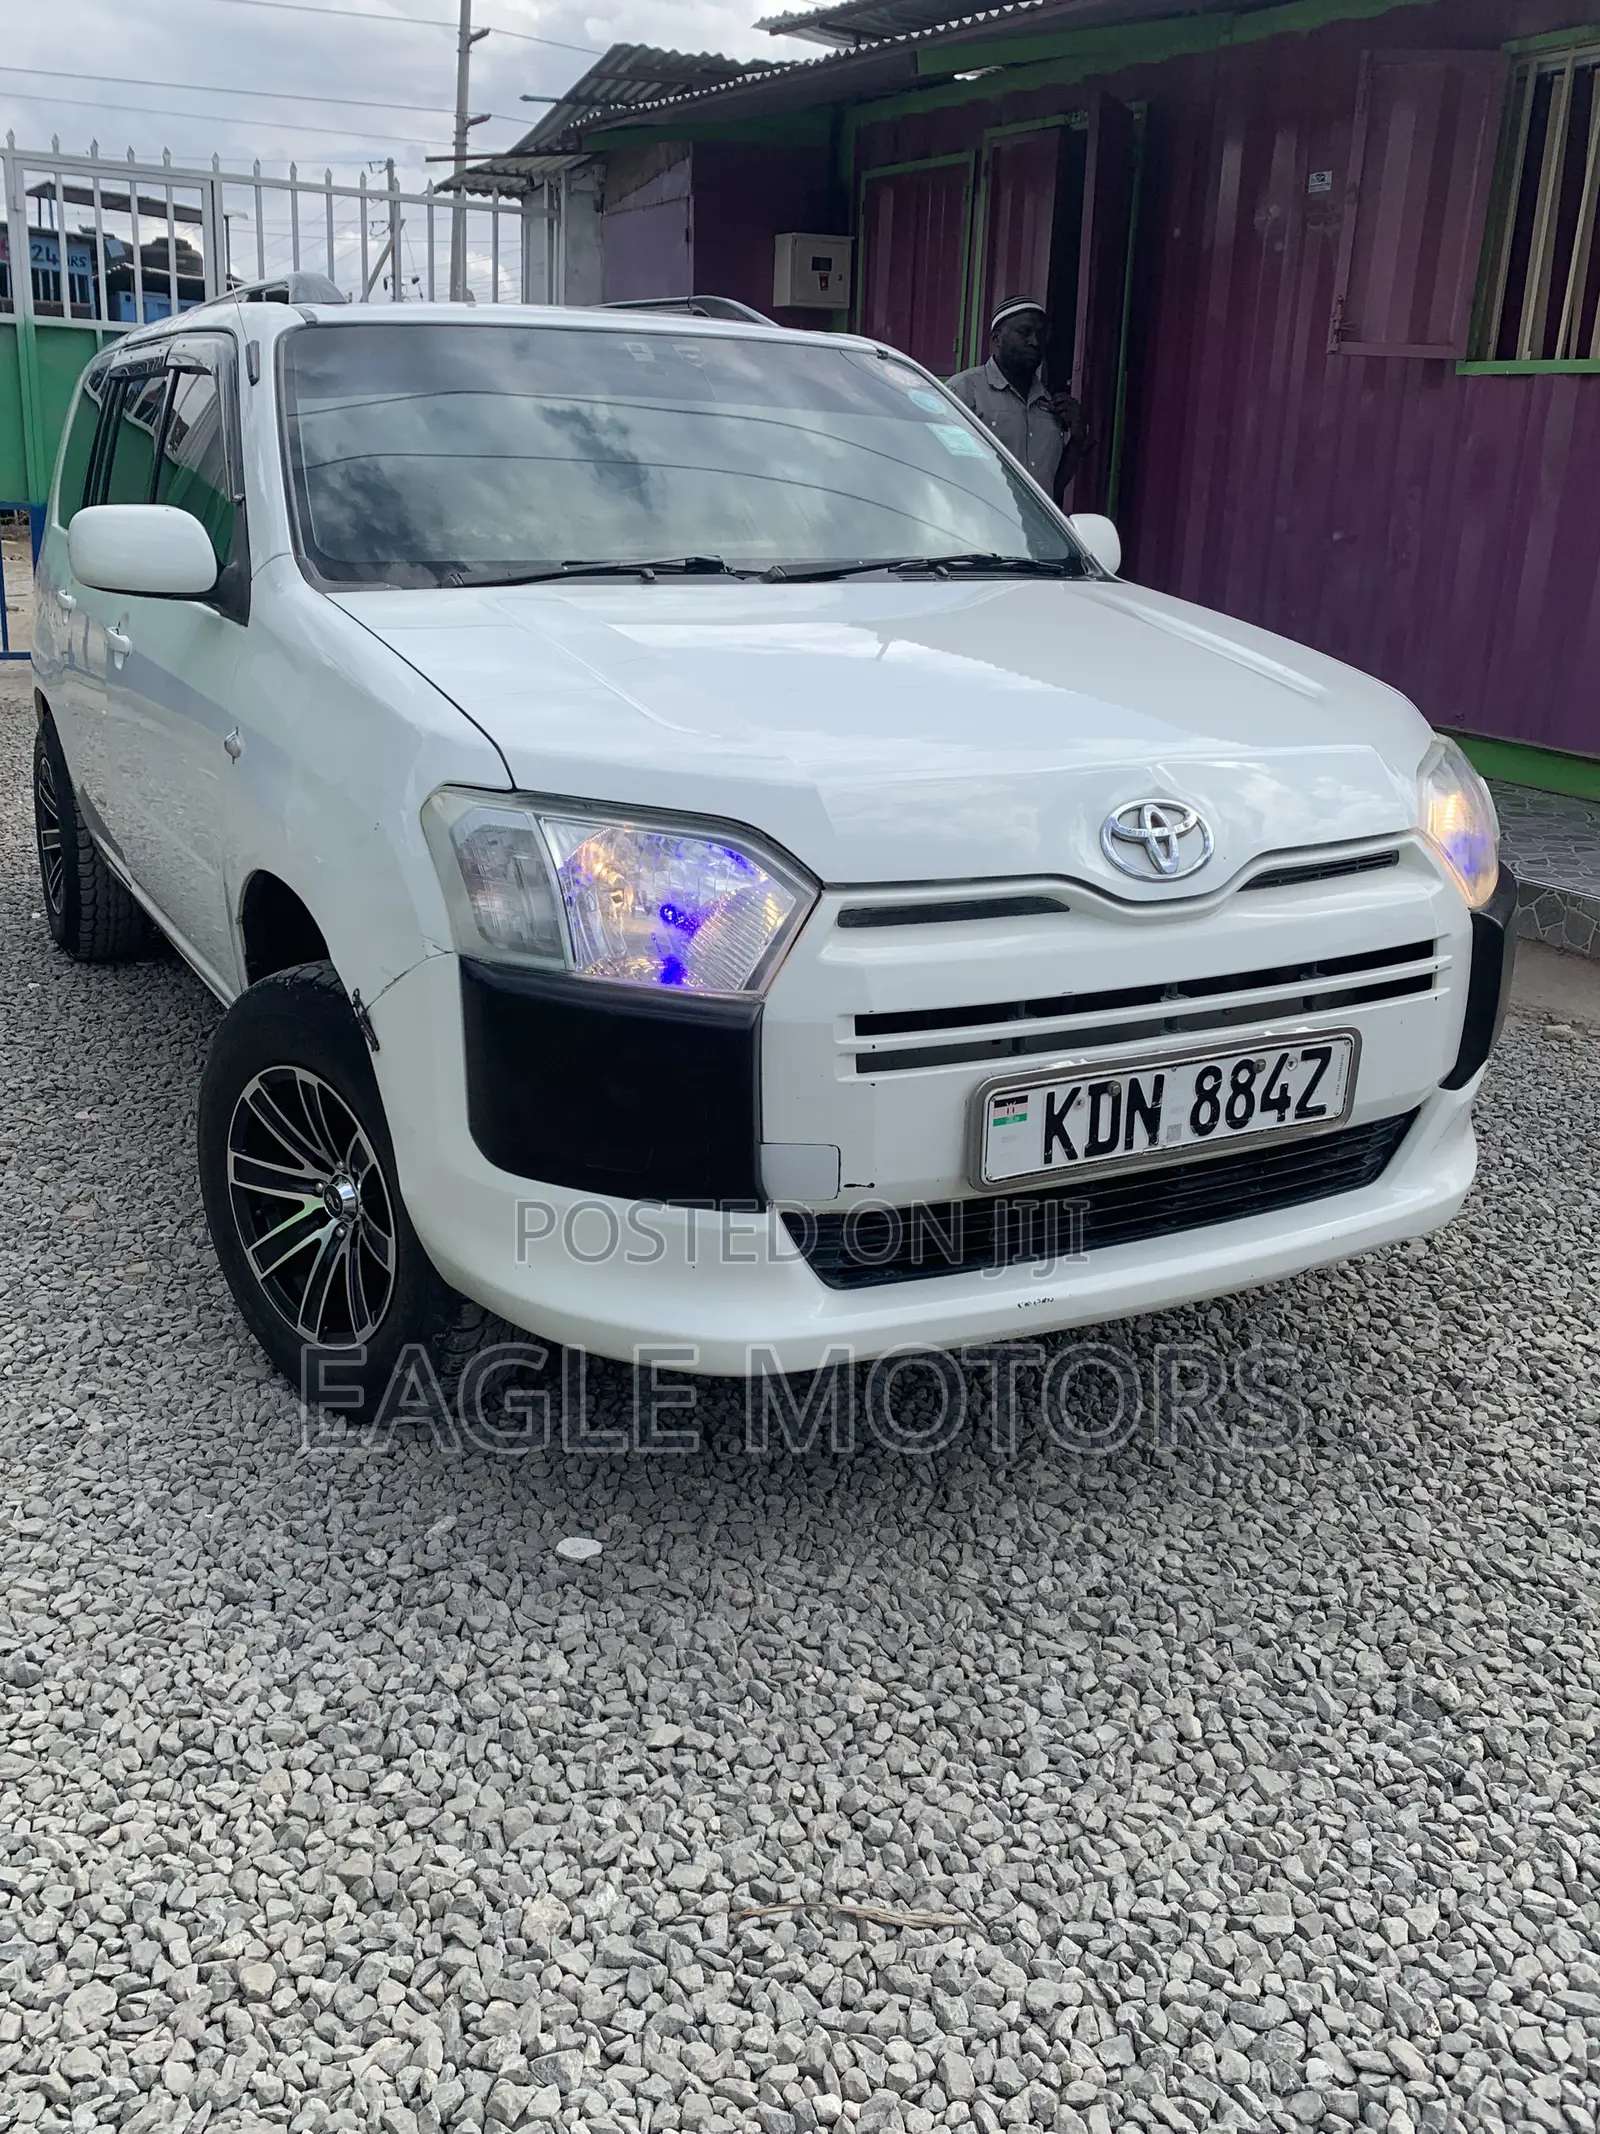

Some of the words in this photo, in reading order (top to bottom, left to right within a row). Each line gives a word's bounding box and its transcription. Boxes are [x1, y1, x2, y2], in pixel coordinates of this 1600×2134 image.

[31, 244, 60, 266] 24
[1043, 1074, 1165, 1165] KDN
[1189, 1046, 1333, 1137] 884Z
